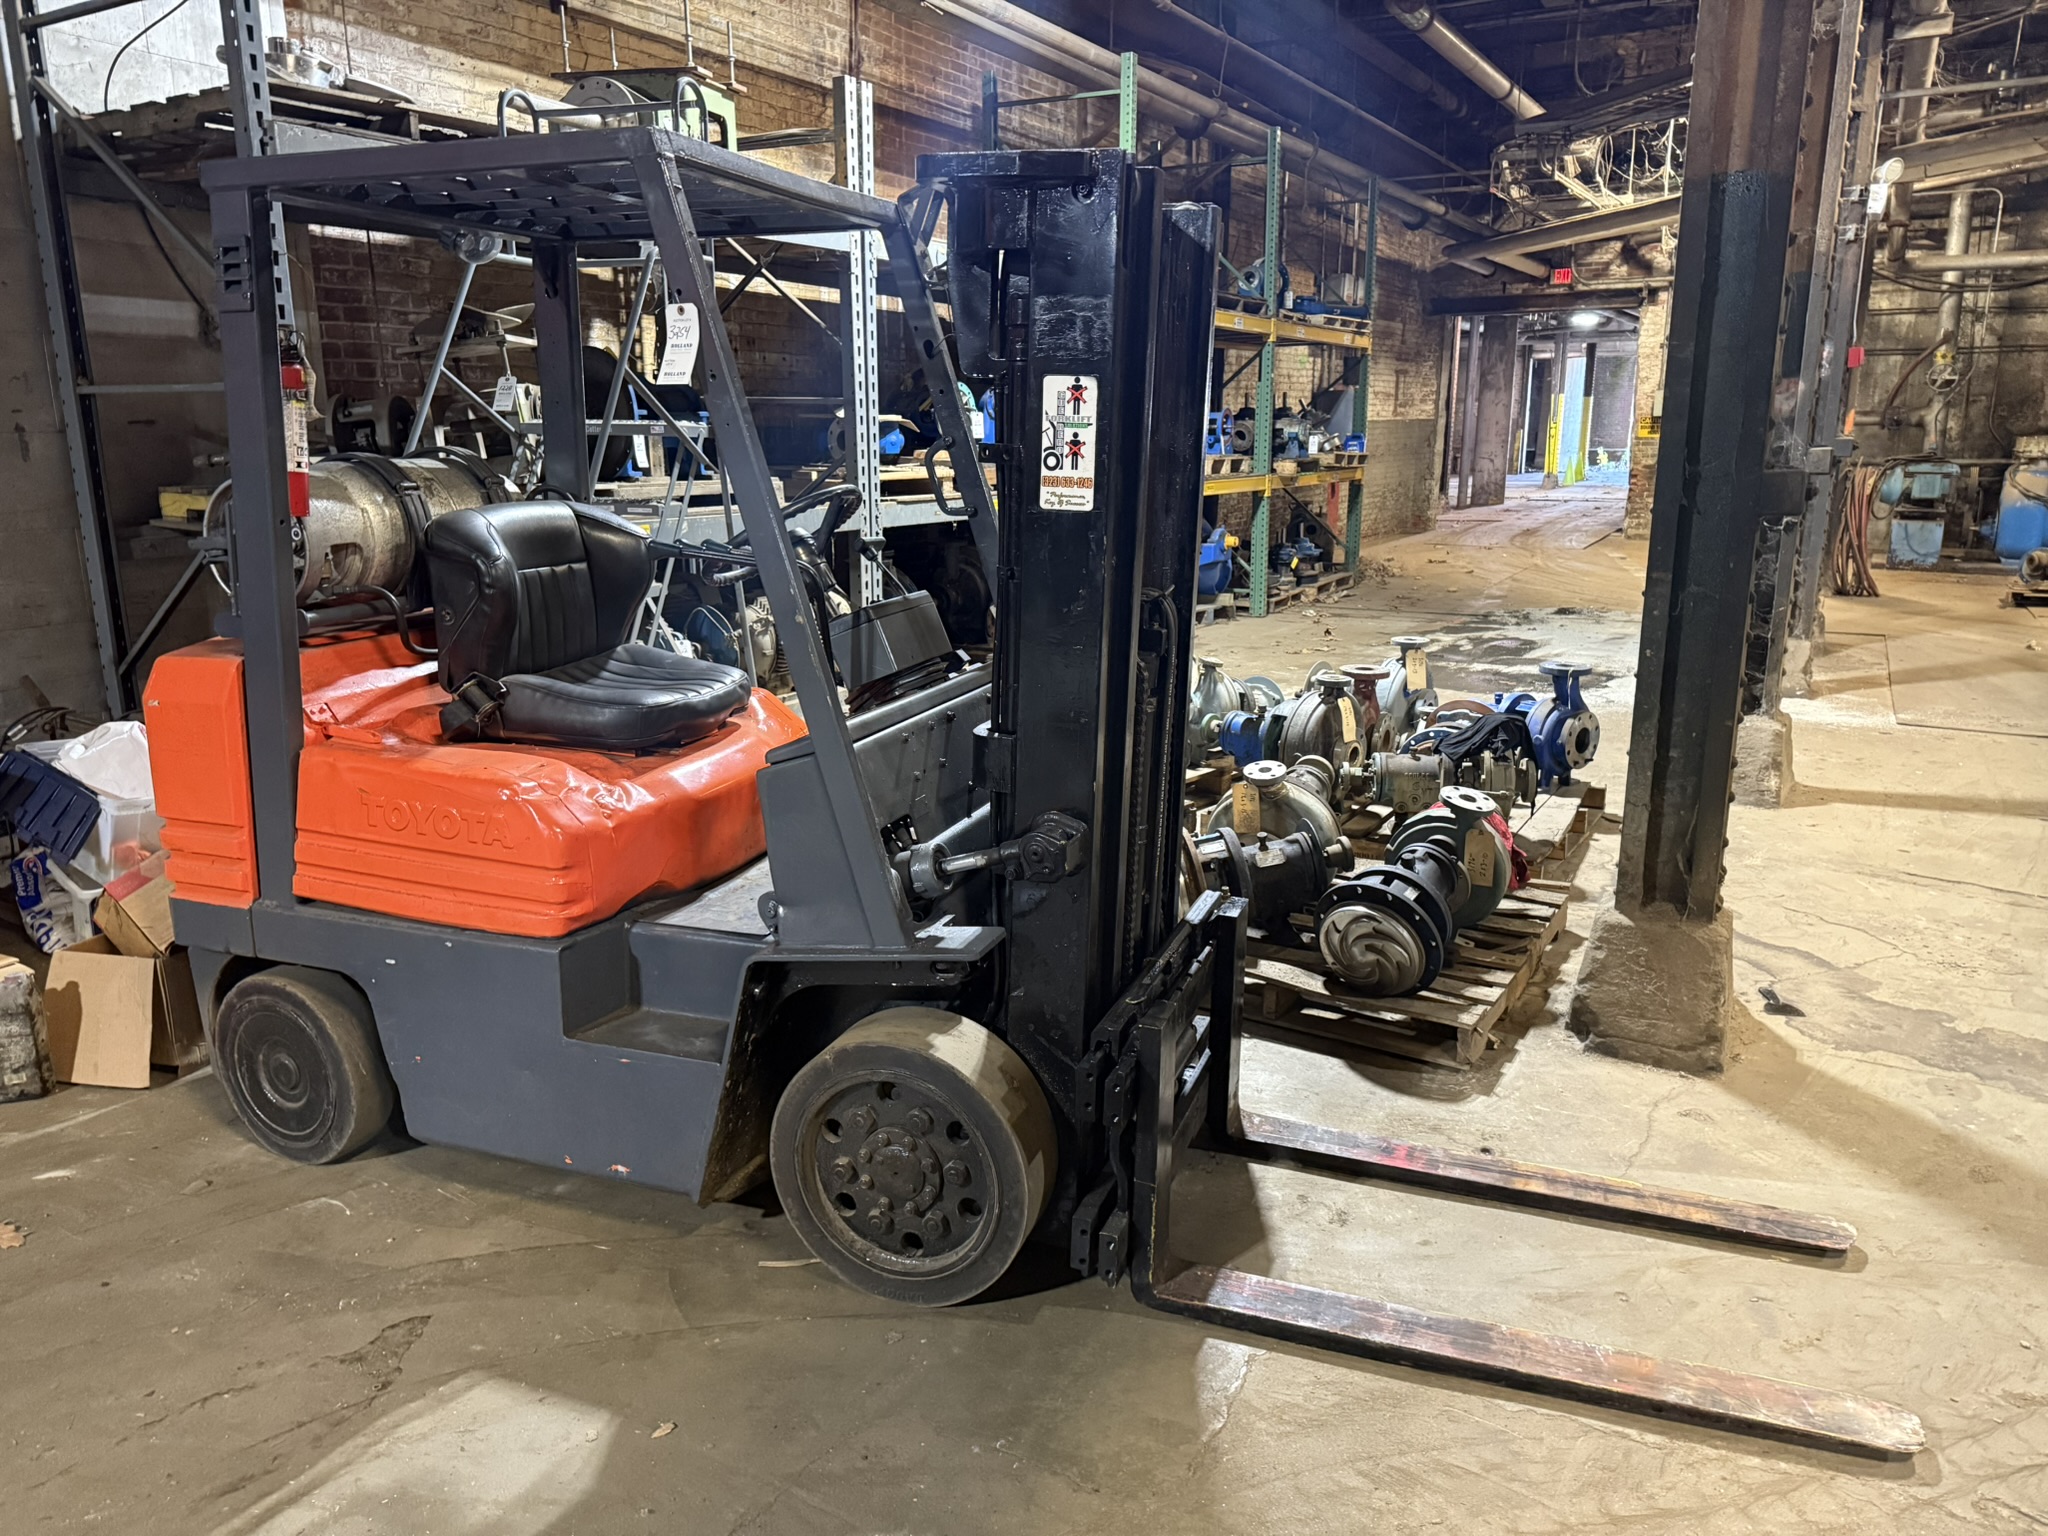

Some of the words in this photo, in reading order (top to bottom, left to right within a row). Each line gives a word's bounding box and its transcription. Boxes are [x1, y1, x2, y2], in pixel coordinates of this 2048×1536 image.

[1046, 415, 1092, 423] FORKLIFT
[1042, 476, 1060, 487] (323)
[360, 793, 514, 849] TOYOTA
